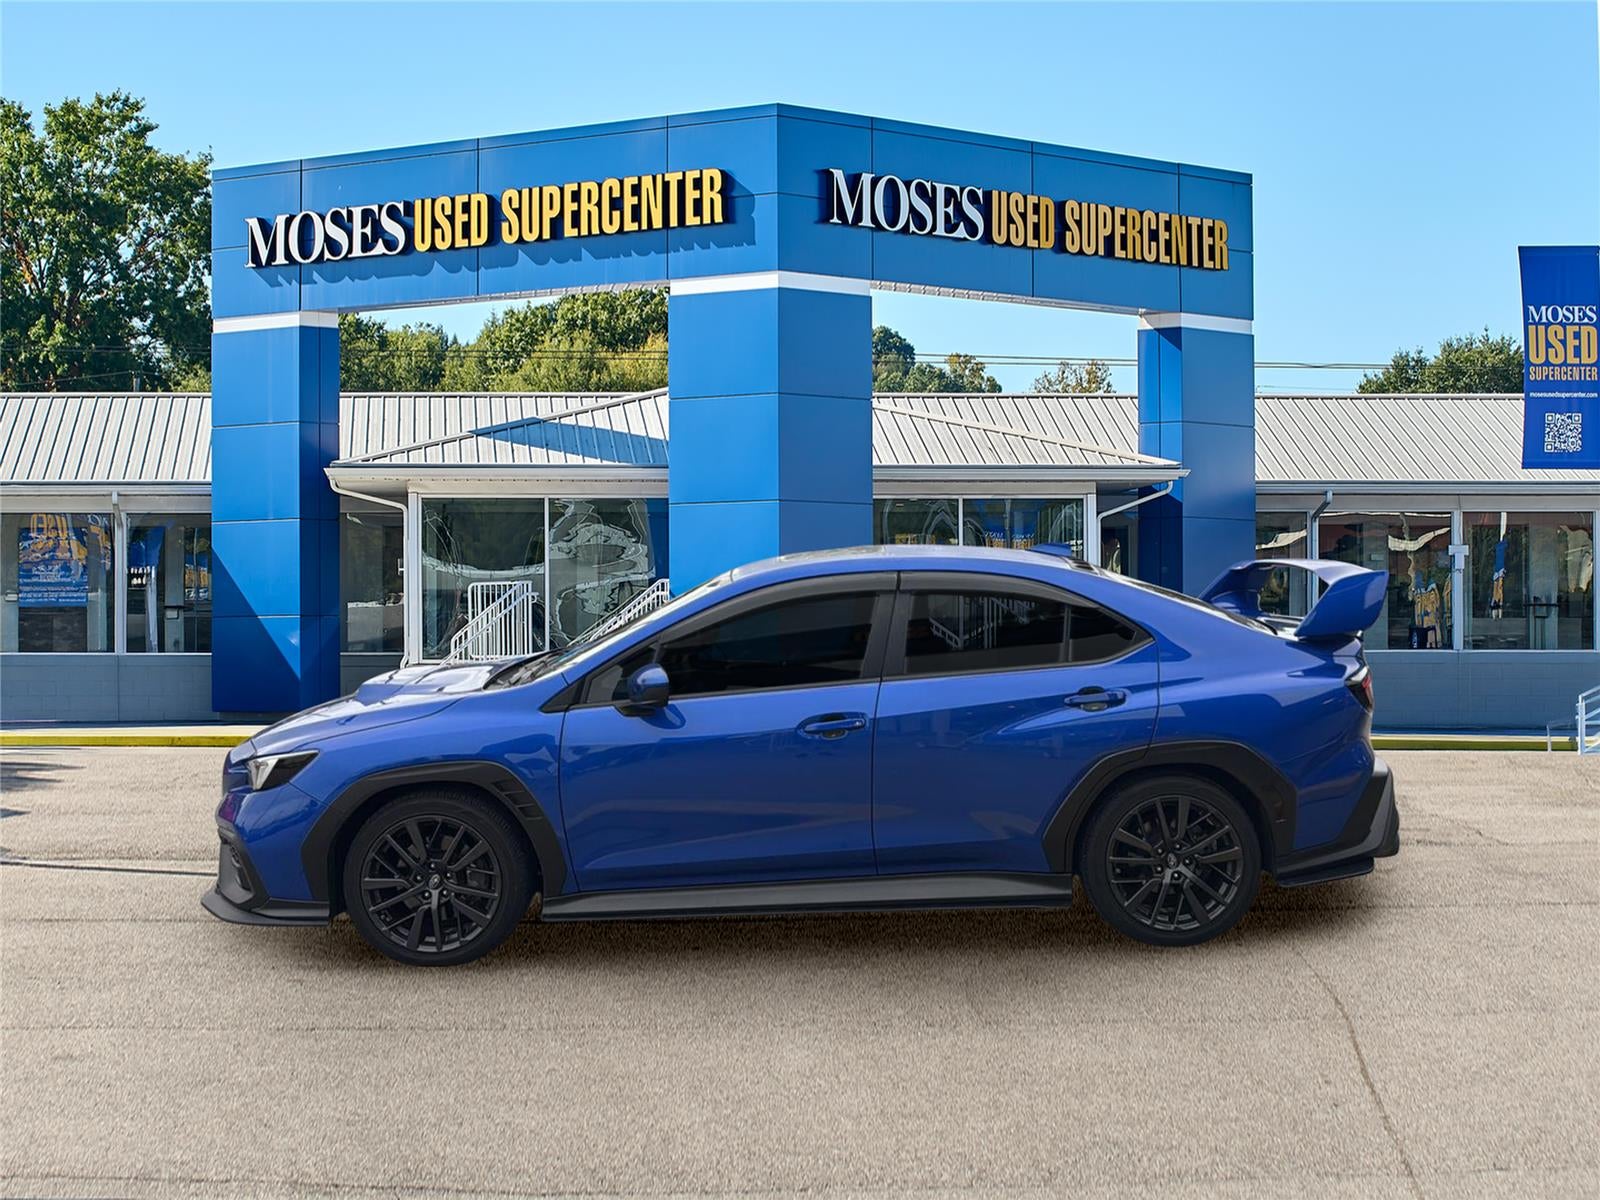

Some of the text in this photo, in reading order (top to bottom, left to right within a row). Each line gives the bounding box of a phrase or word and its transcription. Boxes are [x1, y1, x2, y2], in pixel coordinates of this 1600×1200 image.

[244, 168, 724, 268] MOSES USED SUPERCENTER
[829, 168, 1230, 271] MOSES USED SUPERCENTER
[1527, 305, 1597, 323] MOSES
[1528, 325, 1598, 365] USED
[1529, 366, 1598, 381] SUPERCENTER
[1529, 391, 1598, 399] mosesusedsupercenter.com
